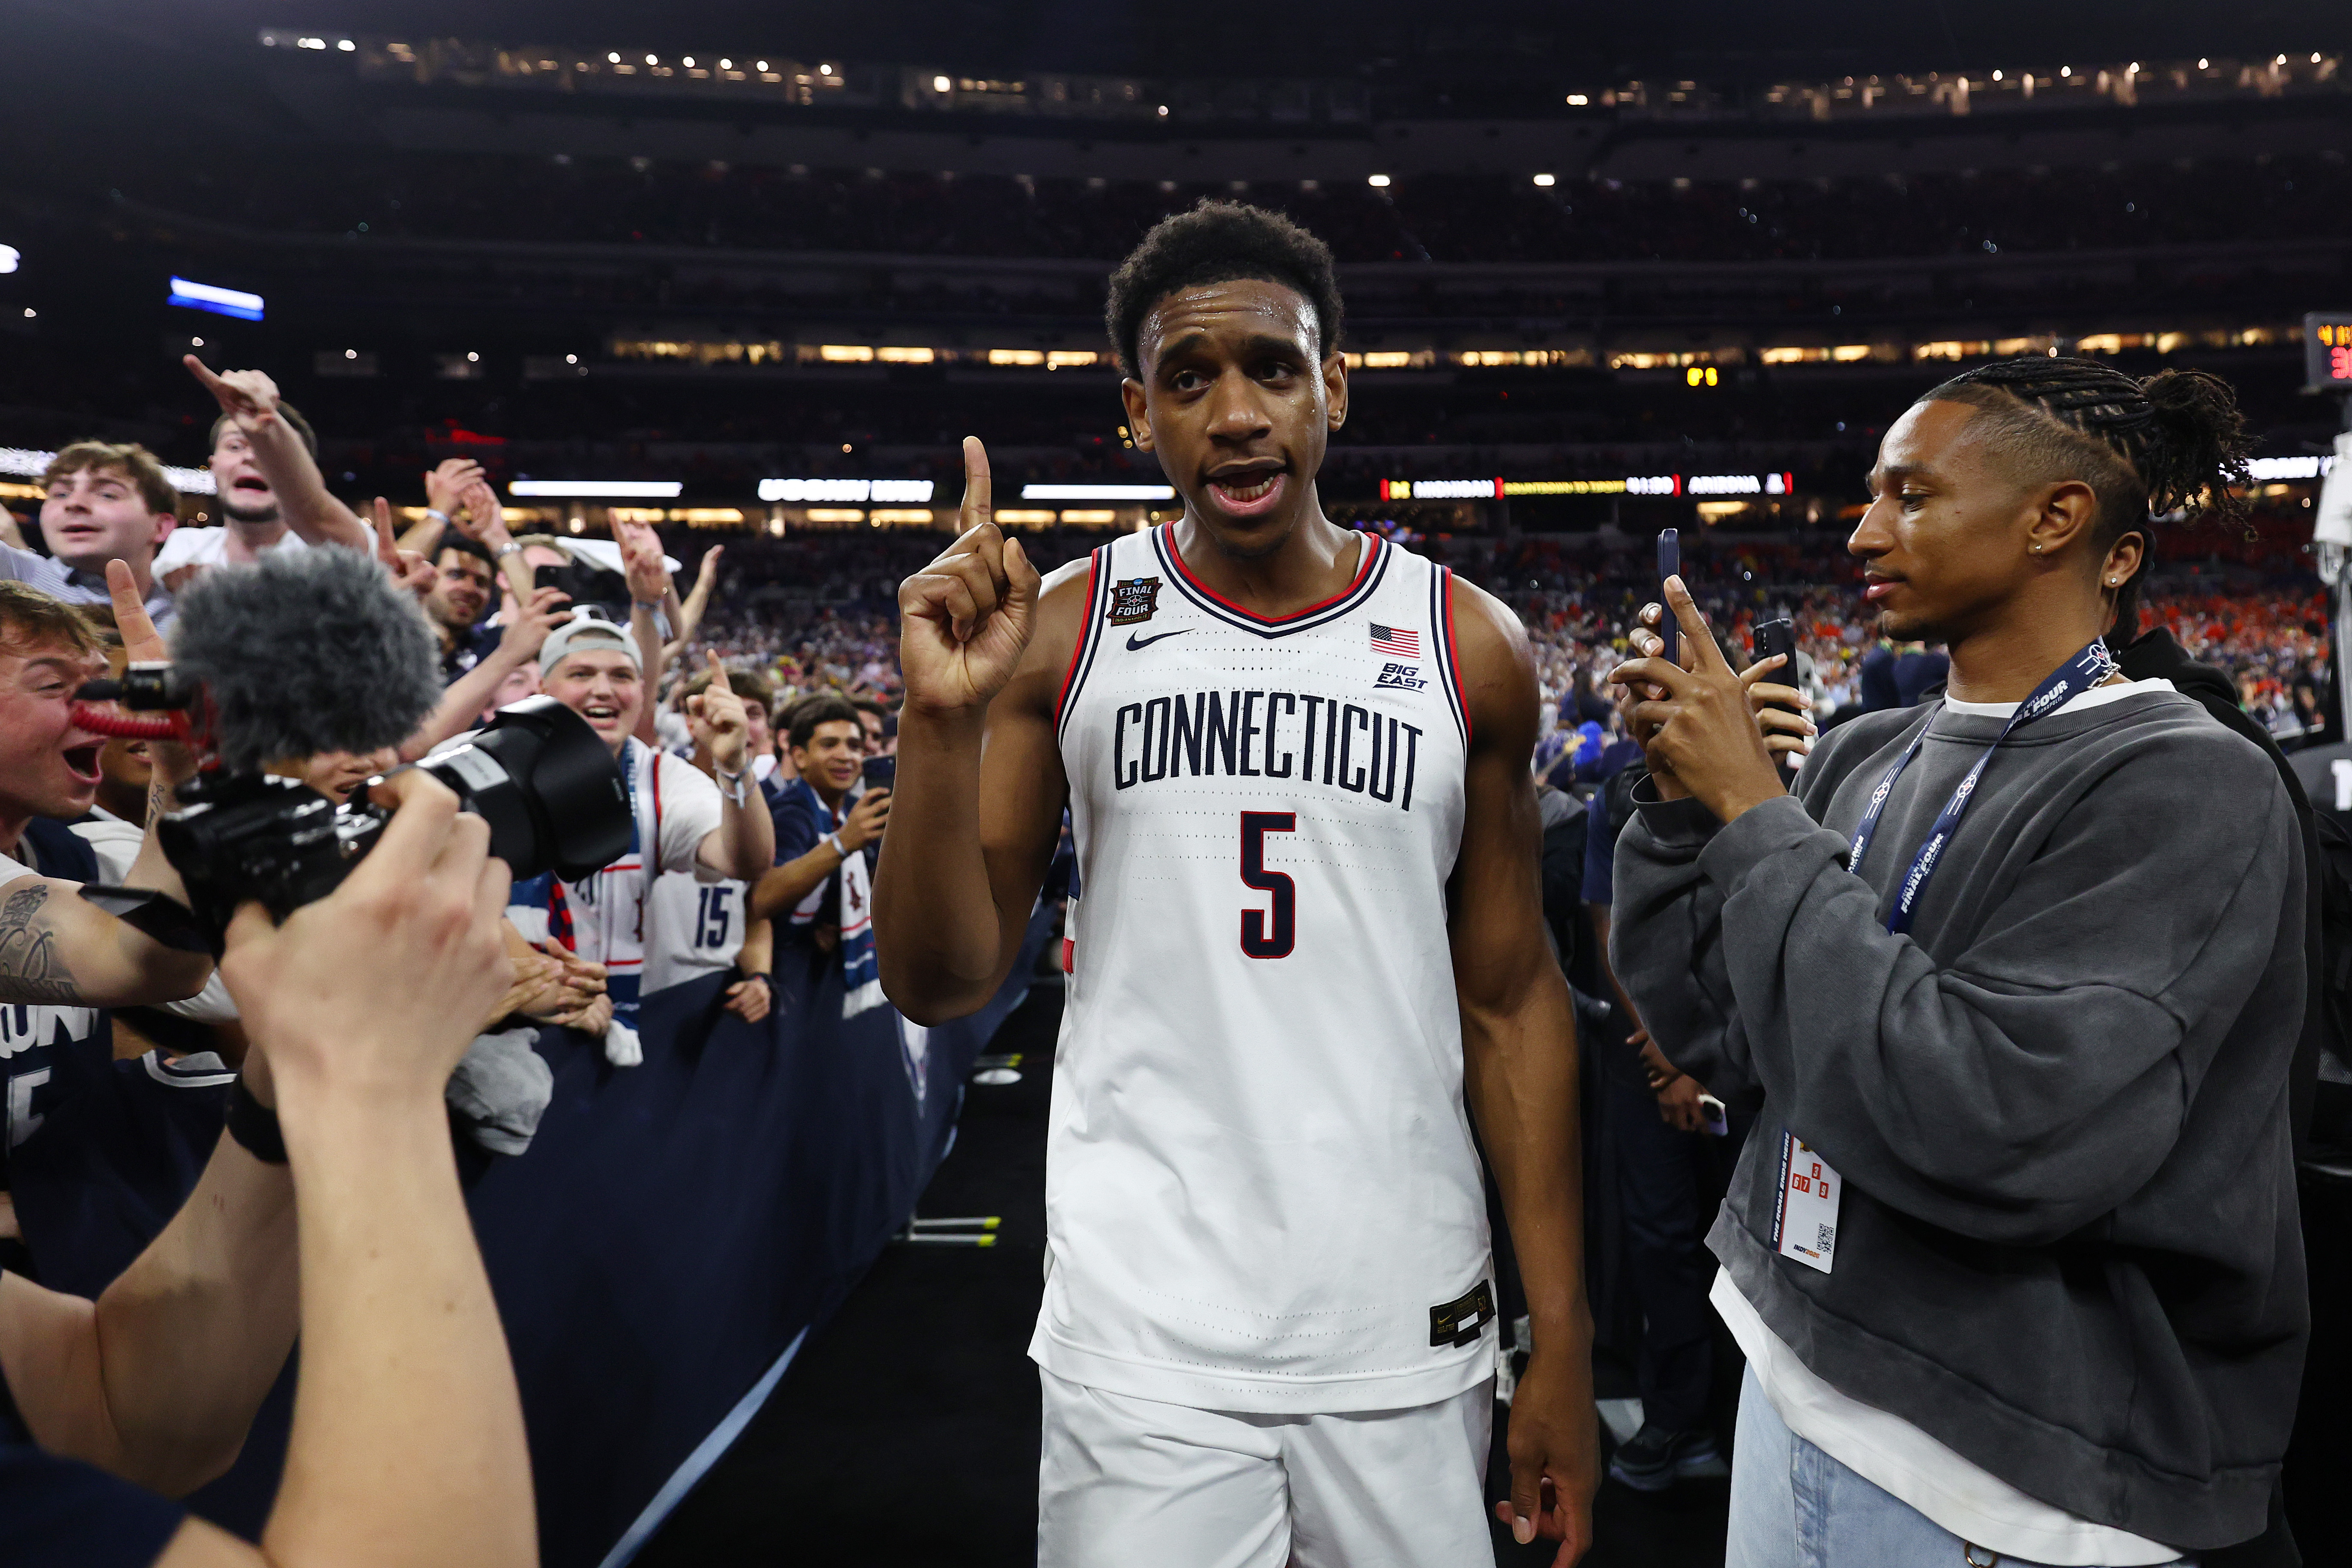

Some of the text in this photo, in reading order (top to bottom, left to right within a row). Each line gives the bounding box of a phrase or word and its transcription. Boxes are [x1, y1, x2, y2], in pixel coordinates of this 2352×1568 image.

[1413, 479, 1495, 499] MICHIGAN
[1688, 475, 1761, 494] ARIZONA
[1119, 585, 1152, 597] FINAL
[1116, 604, 1149, 616] FOUR
[1382, 663, 1420, 676] BIG
[1377, 673, 1428, 689] EAST
[1114, 691, 1423, 811] CONNECTICUT
[1900, 833, 1945, 914] FINAL FOUR
[1240, 811, 1296, 959] 5
[695, 887, 733, 948] 15
[1813, 1166, 1819, 1177] 3
[1820, 1185, 1826, 1196] 9
